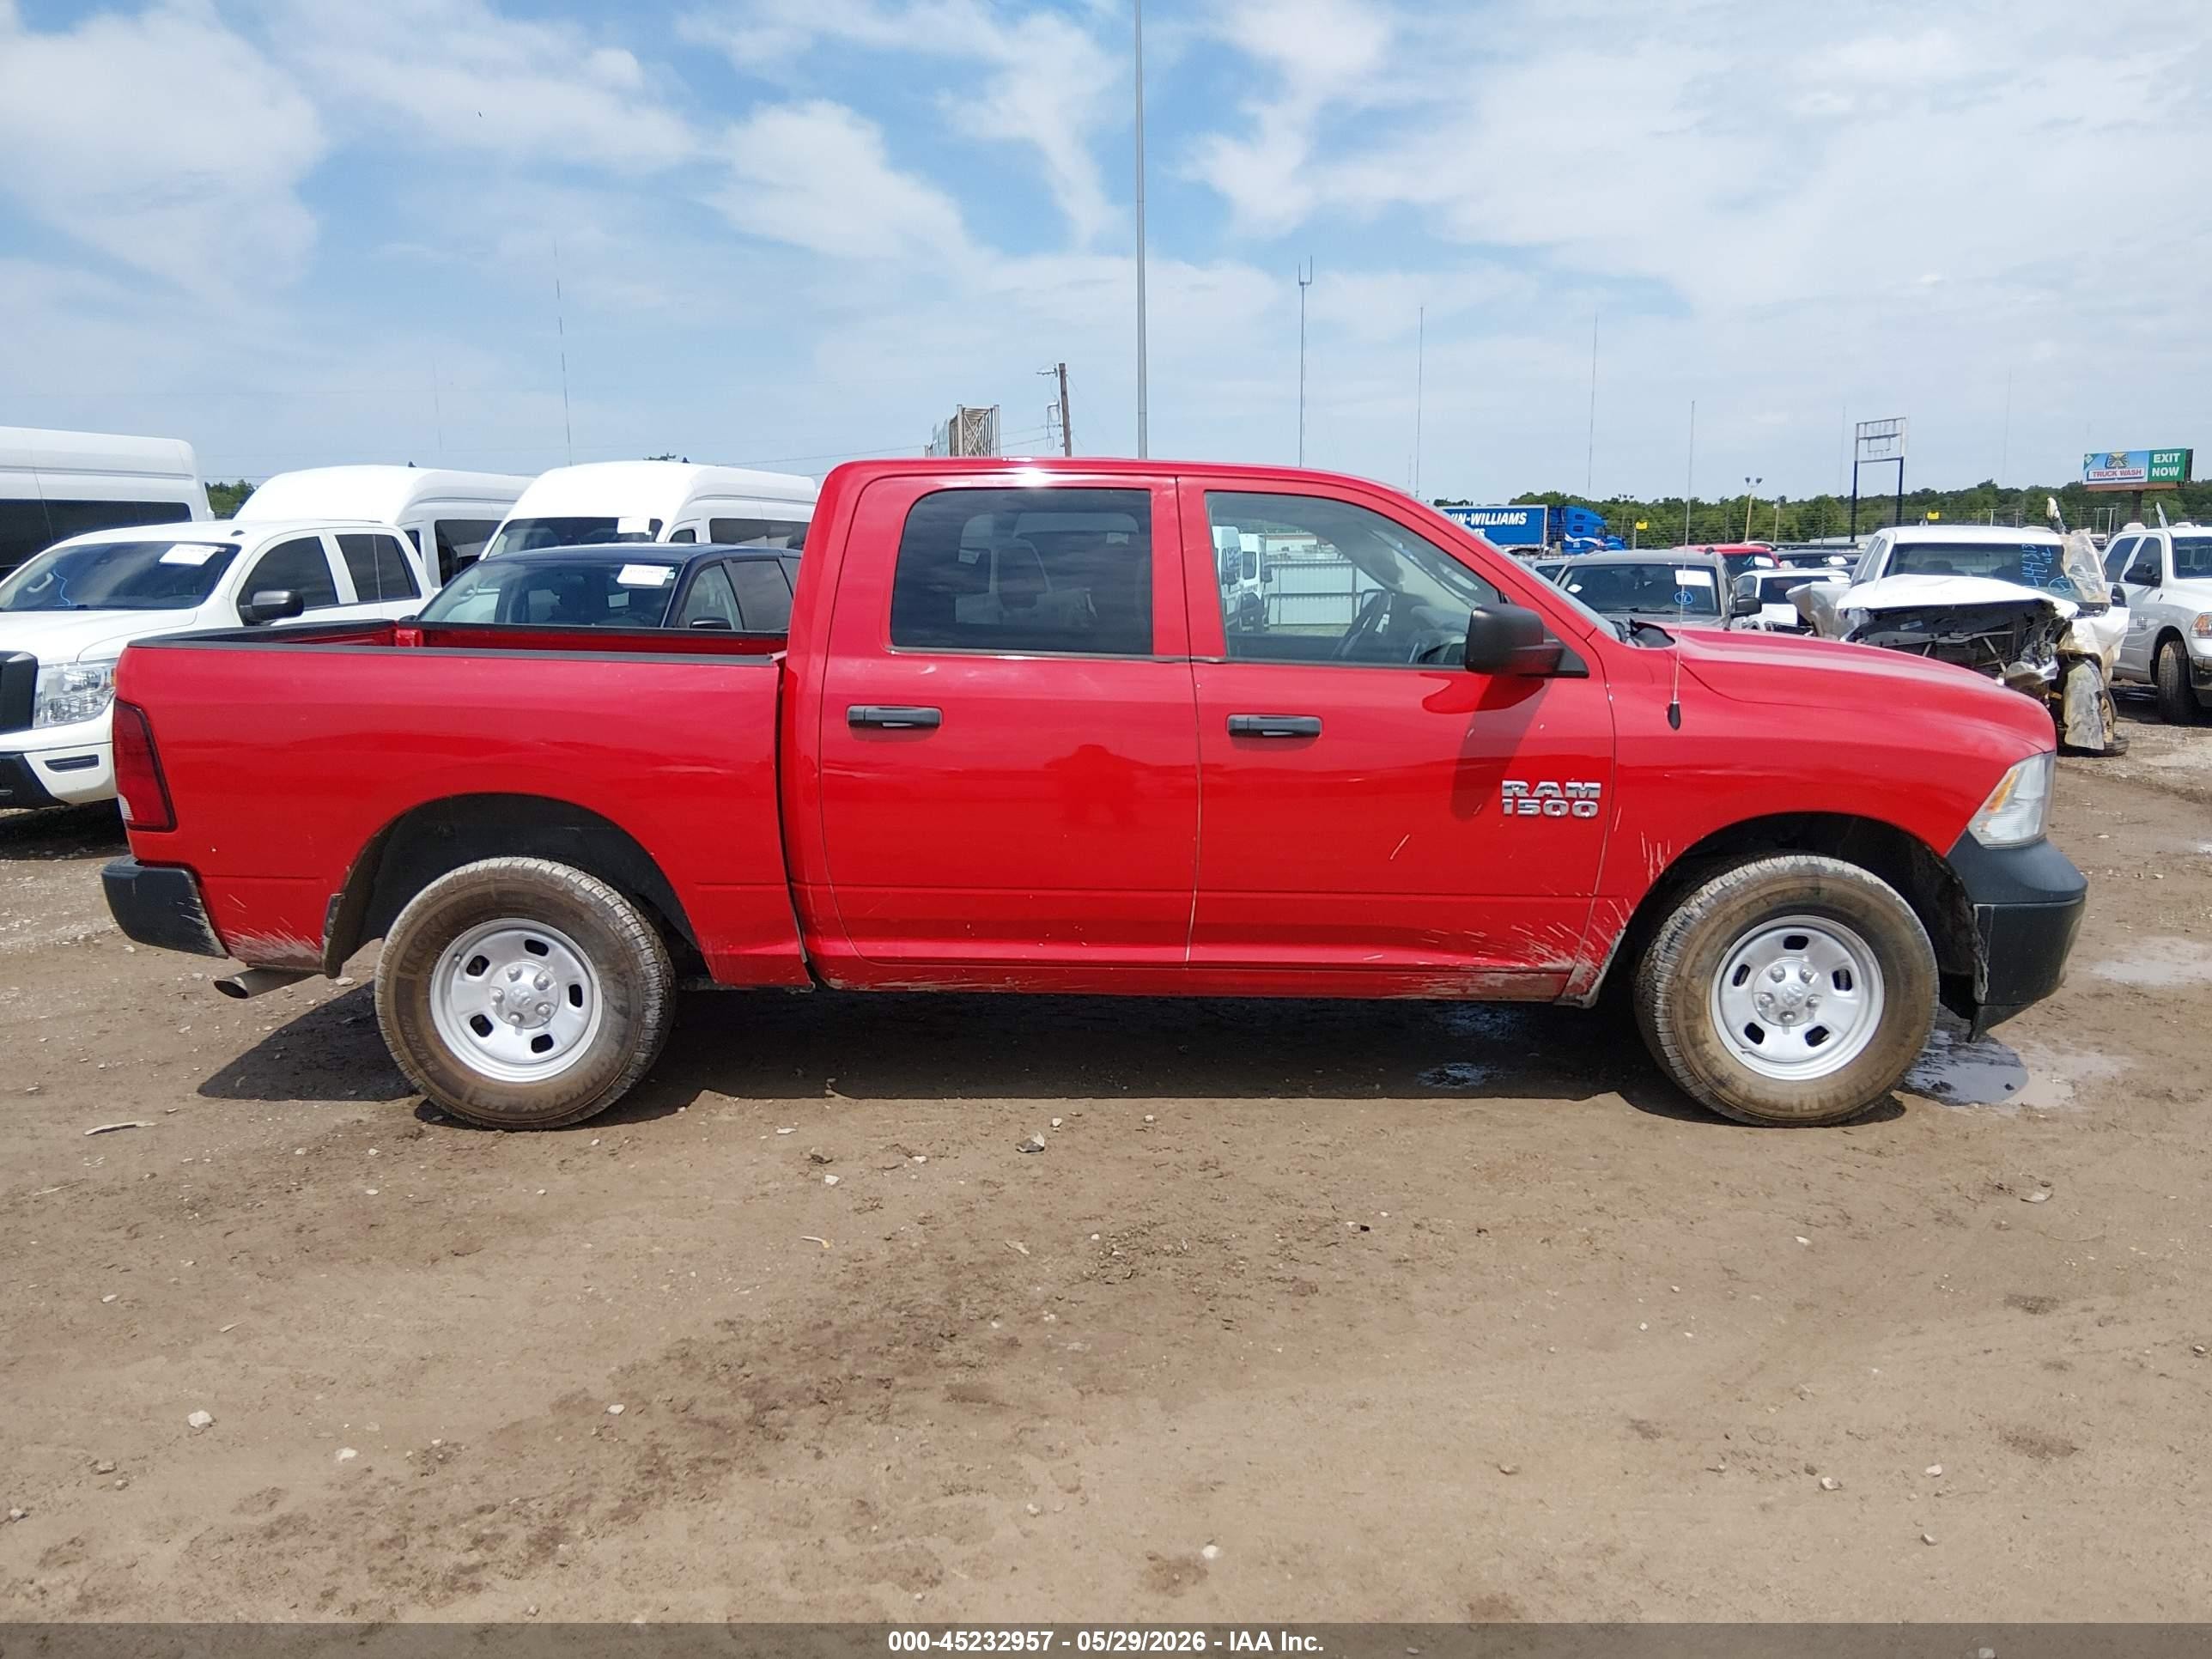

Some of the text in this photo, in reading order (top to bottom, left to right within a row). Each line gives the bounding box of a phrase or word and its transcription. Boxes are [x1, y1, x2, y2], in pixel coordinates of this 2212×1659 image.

[2154, 453, 2181, 464] EXIT
[2092, 468, 2142, 478] TRUCK WASH
[2152, 466, 2179, 477] NOW
[1501, 780, 1602, 799] RAM
[1501, 798, 1599, 817] 1500
